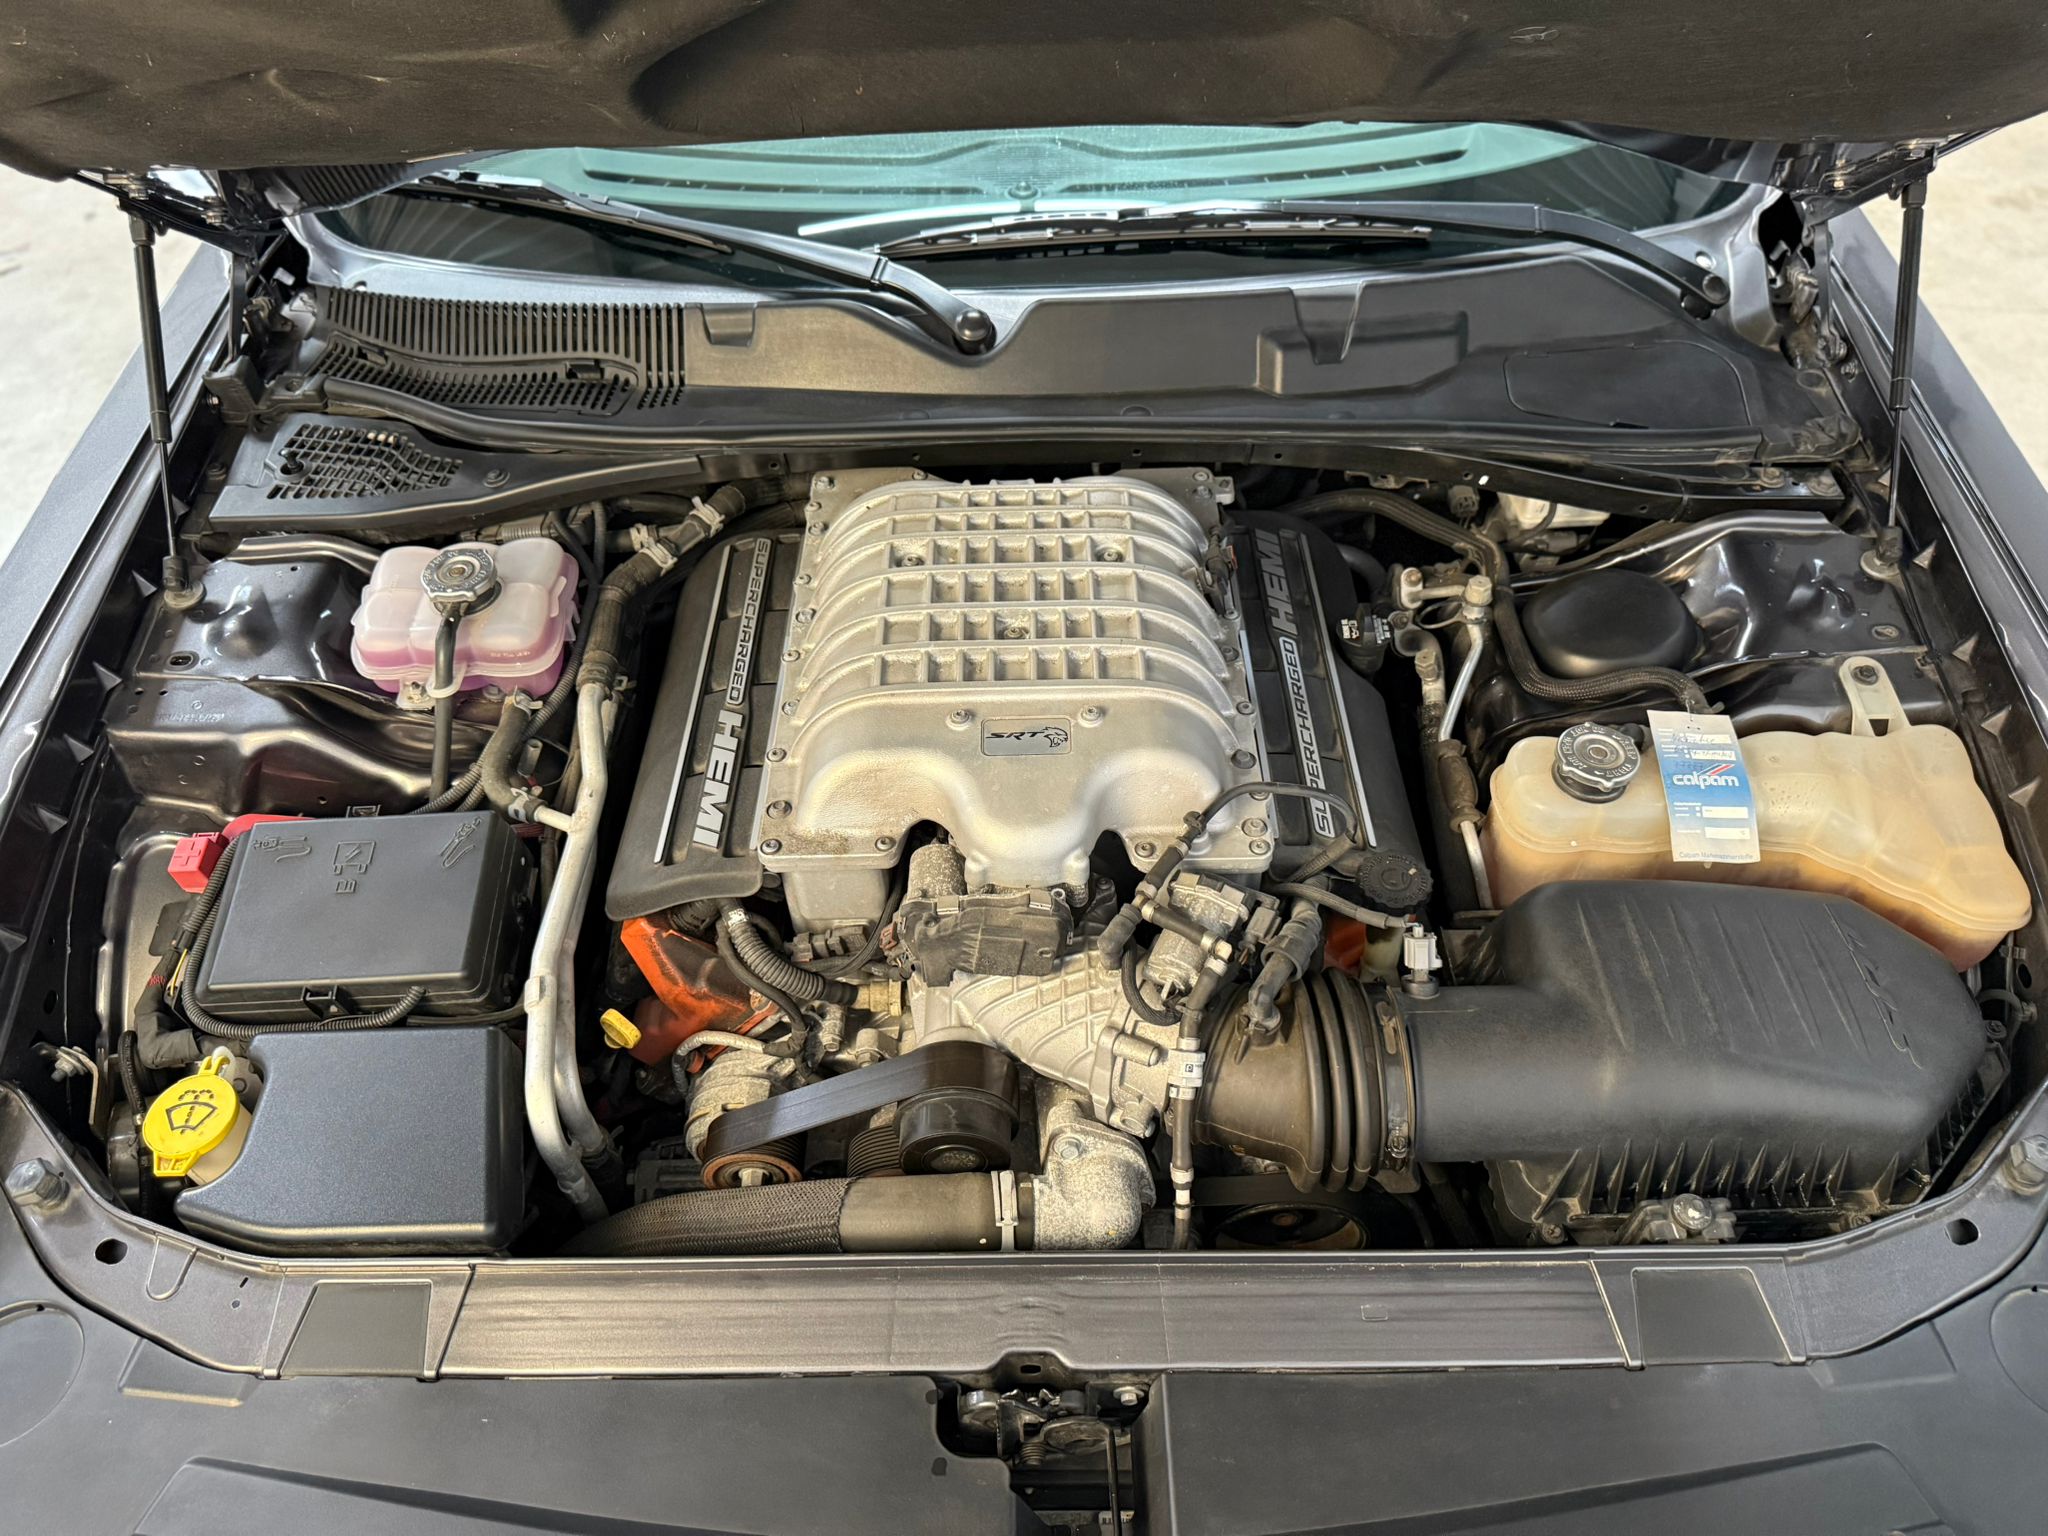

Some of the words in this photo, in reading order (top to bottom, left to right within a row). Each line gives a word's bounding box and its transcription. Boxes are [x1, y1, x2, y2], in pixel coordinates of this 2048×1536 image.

[728, 538, 771, 703] SUPERCHARGED
[1254, 527, 1298, 636] HEMI
[692, 708, 743, 849] HEMI
[984, 731, 1045, 741] SRT
[1672, 770, 1740, 790] calpam
